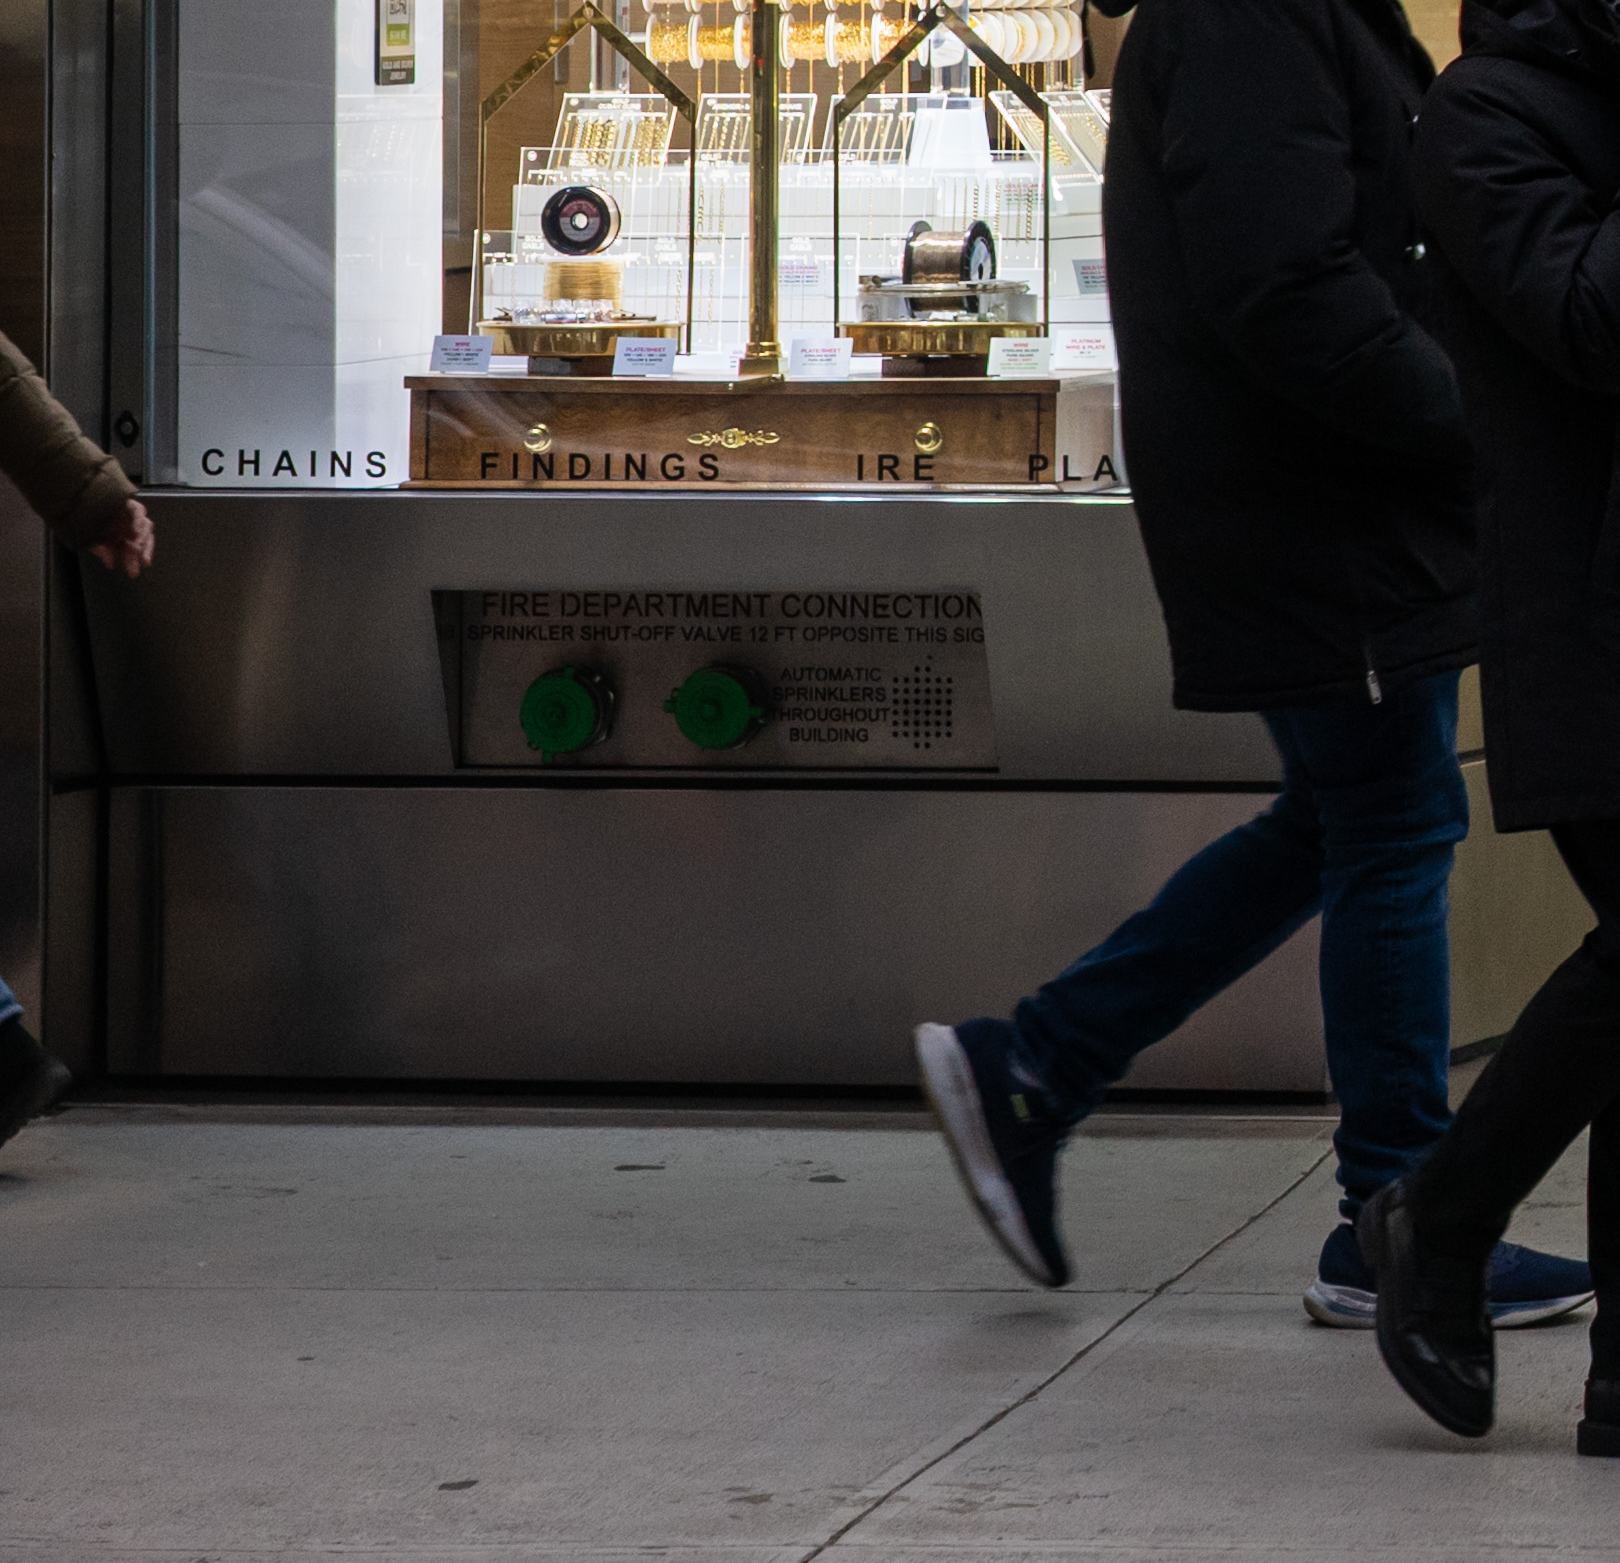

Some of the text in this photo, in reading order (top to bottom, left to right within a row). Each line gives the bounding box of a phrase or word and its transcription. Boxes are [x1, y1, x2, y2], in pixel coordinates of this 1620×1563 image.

[201, 449, 390, 479] CHAINS
[480, 451, 722, 482] FINDINGS
[483, 593, 983, 619] FIRE DEPARTMENT CONNECTION
[467, 625, 576, 641] SPRINKLER
[580, 625, 676, 641] SHUT-OFF
[681, 625, 743, 642] VALVE
[748, 626, 770, 642] 12
[773, 626, 798, 642] FT
[802, 626, 899, 643] OPPOSITE
[904, 626, 950, 643] THIS
[780, 667, 882, 682] AUTOMATIC
[772, 686, 887, 702] SPRINKLERS
[770, 707, 890, 722] THROUGHOUT
[789, 728, 869, 742] BUILDING
